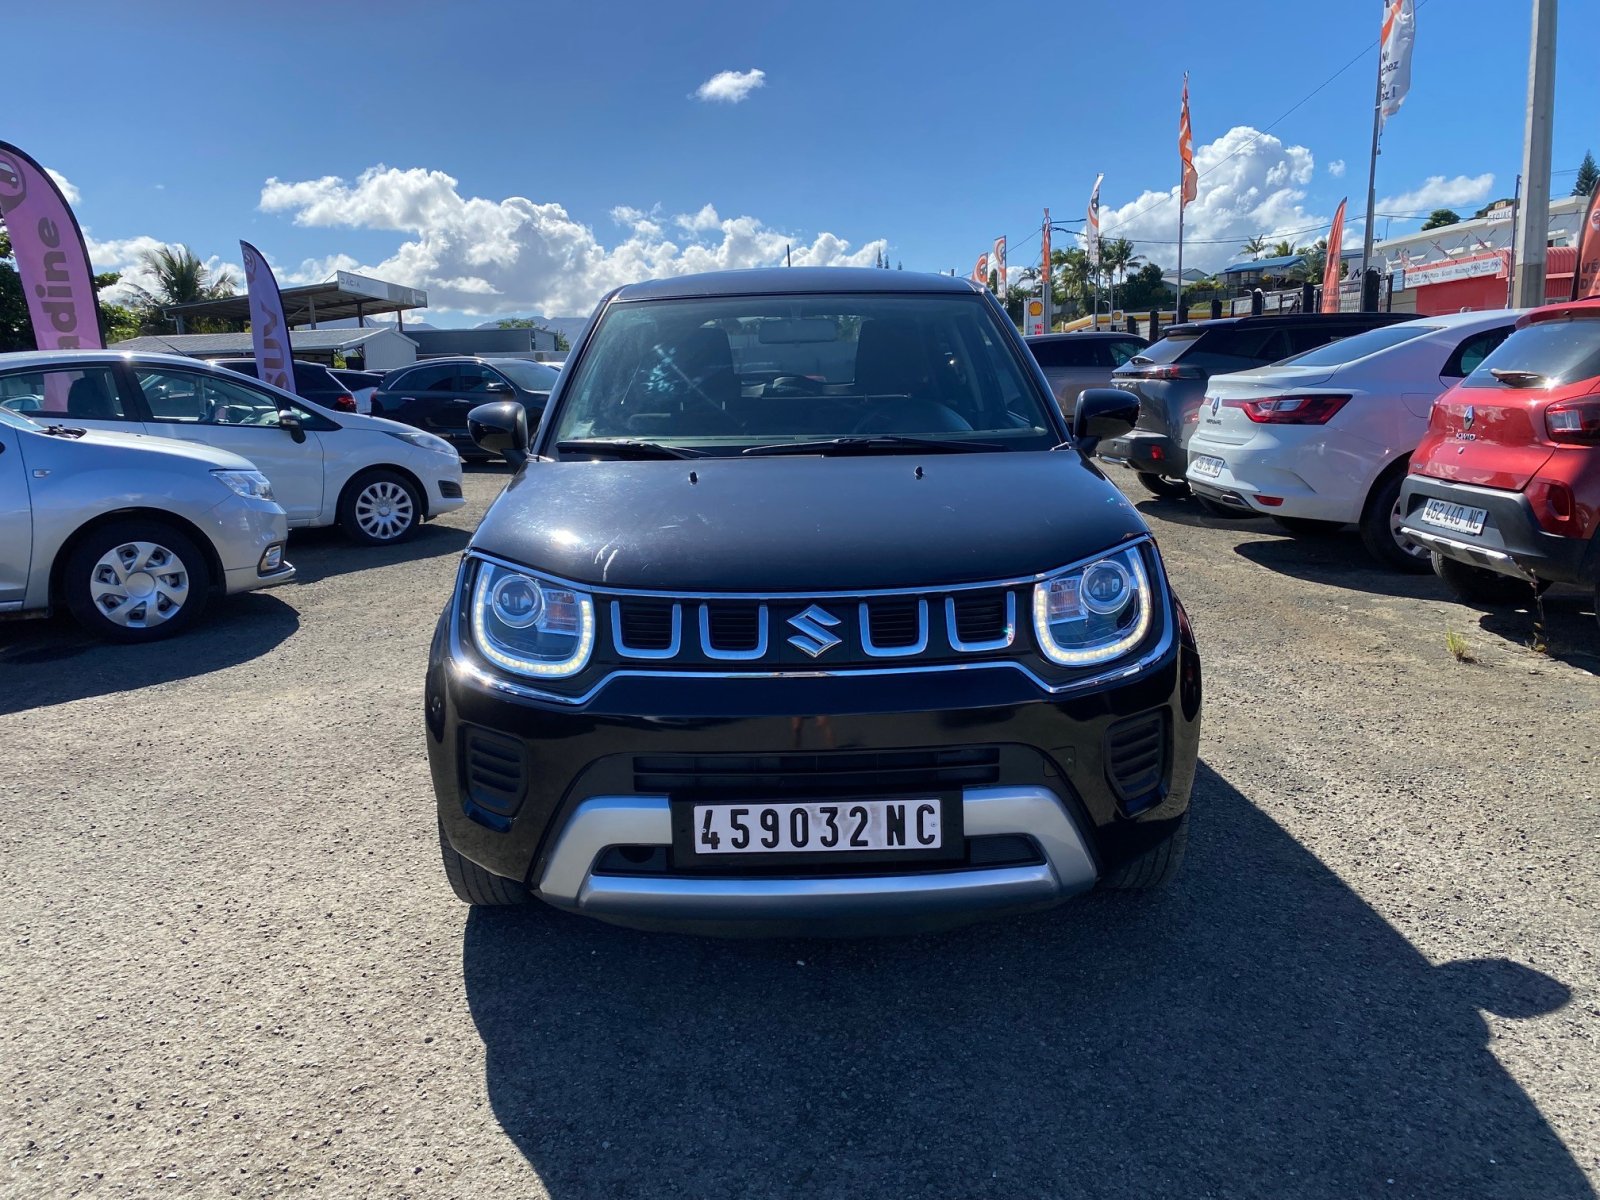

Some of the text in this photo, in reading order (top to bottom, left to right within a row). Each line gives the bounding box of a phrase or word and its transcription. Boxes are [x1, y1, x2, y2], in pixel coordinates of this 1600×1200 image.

[1456, 432, 1476, 440] KWID
[1466, 508, 1484, 530] NC
[701, 804, 936, 850] 459032 NC
